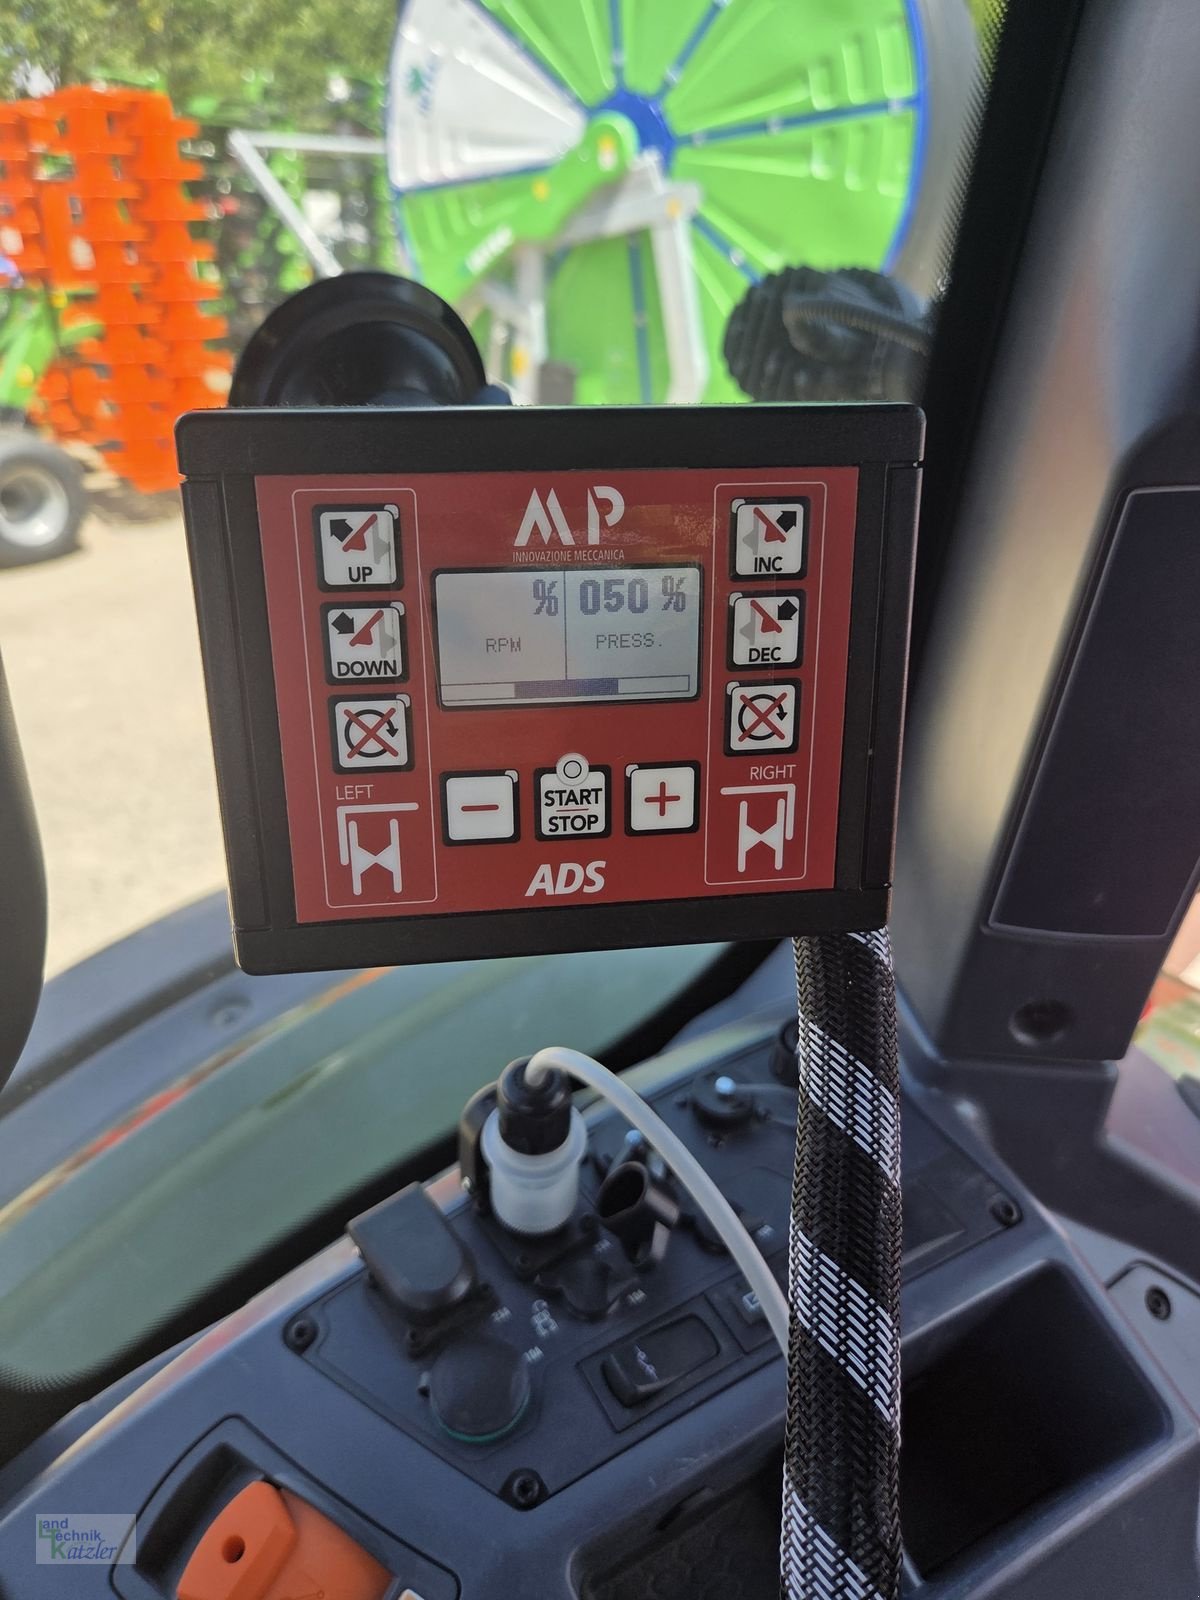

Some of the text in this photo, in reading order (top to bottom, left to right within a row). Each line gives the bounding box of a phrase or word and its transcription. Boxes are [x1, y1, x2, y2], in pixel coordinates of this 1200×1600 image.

[513, 486, 625, 547] MP
[512, 549, 625, 563] INNOVAZIONE MECCANICA
[754, 556, 783, 573] INC
[348, 566, 373, 583] UP
[579, 577, 649, 616] 050
[486, 637, 522, 653] RPM
[596, 632, 663, 650] PRESS.
[748, 646, 782, 663] DEC
[336, 659, 398, 677] DOWN
[750, 764, 797, 780] RIGHT
[335, 784, 374, 801] LEFT
[544, 788, 603, 807] START
[548, 814, 599, 833] STOP
[524, 860, 607, 897] ADS
